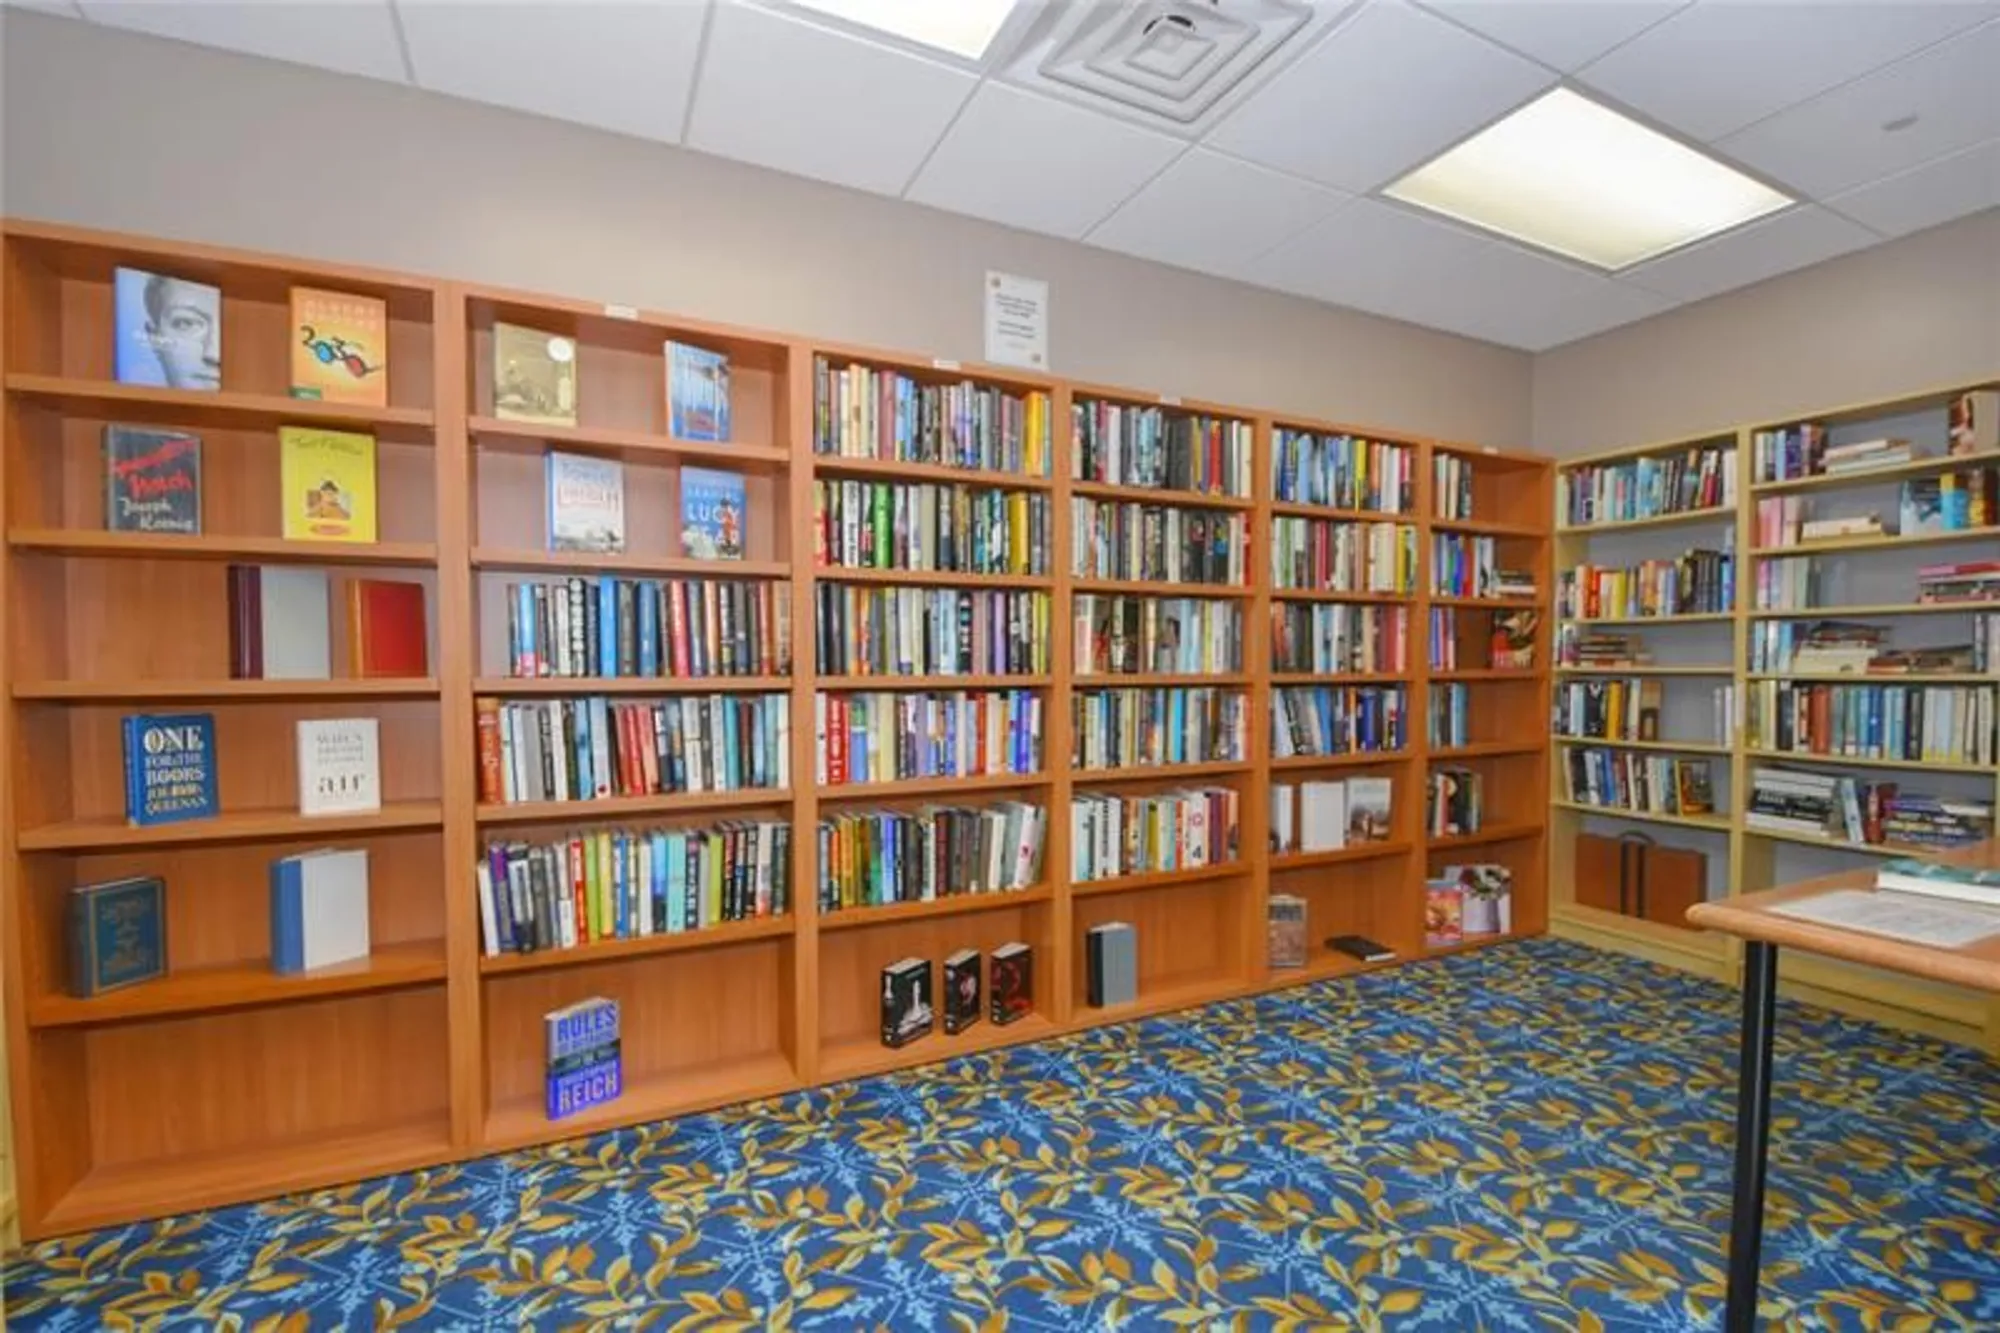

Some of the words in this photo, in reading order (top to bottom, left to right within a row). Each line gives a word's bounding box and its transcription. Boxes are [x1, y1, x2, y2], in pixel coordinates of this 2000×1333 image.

[144, 725, 205, 754] ONE
[146, 767, 206, 786] BOOKS
[557, 1003, 617, 1042] RULES
[559, 1058, 618, 1115] REICH
